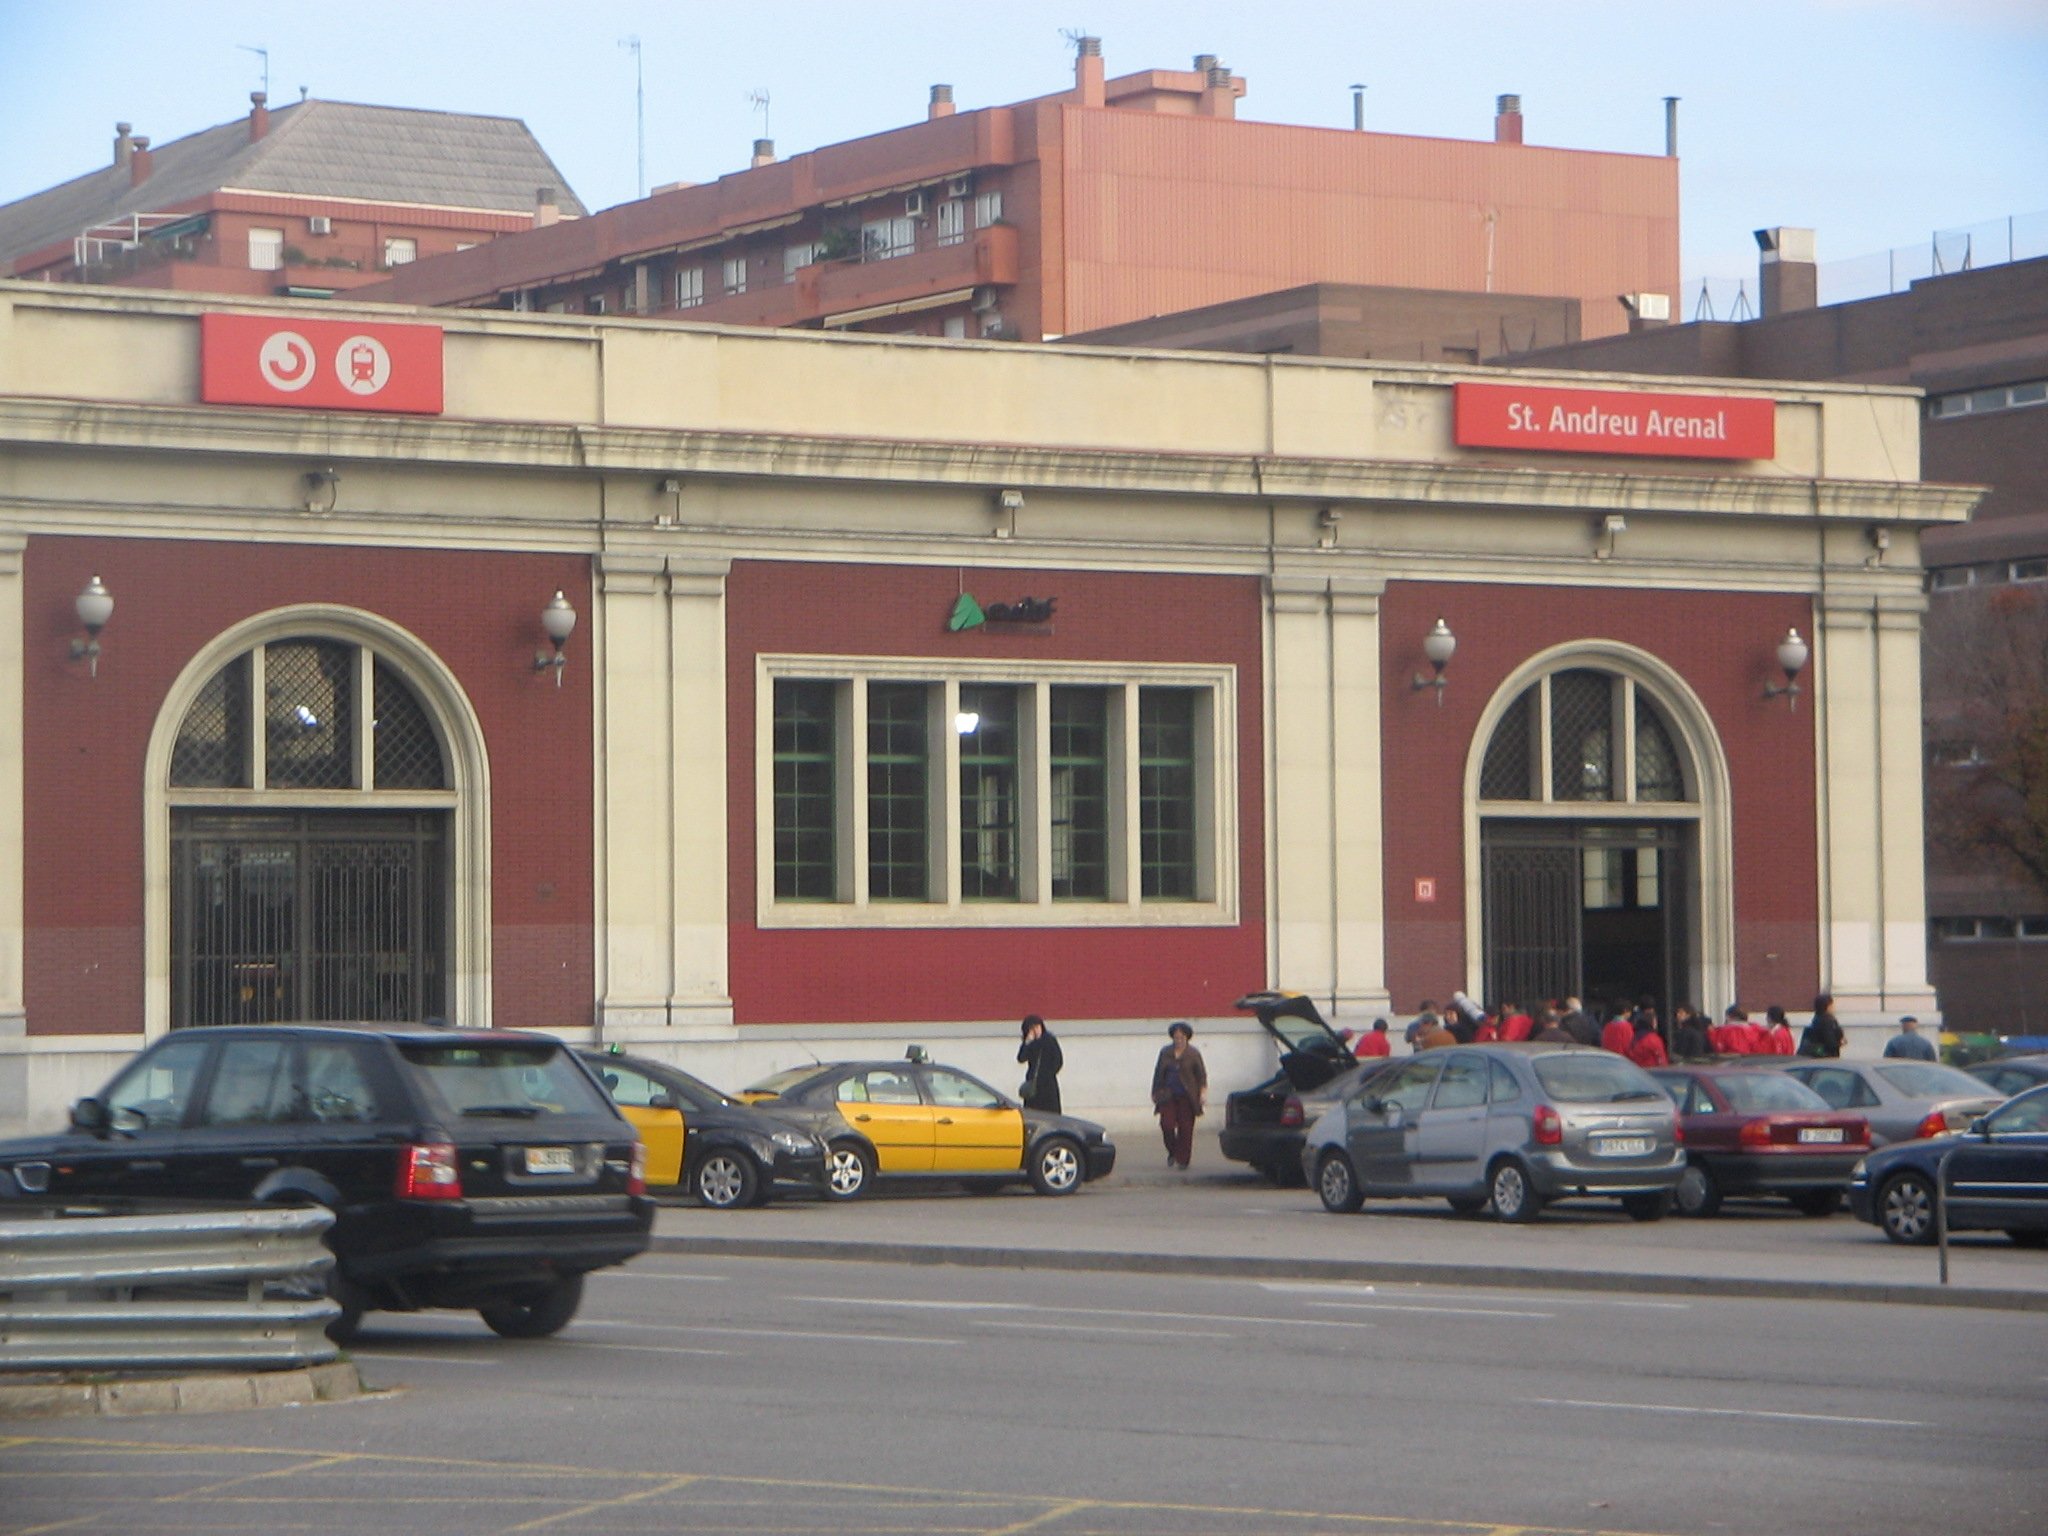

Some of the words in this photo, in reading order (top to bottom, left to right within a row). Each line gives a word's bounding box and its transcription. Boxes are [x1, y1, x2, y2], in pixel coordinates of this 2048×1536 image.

[1507, 402, 1541, 431] St.
[1549, 405, 1638, 436] Andreu
[1646, 409, 1727, 440] Arenal
